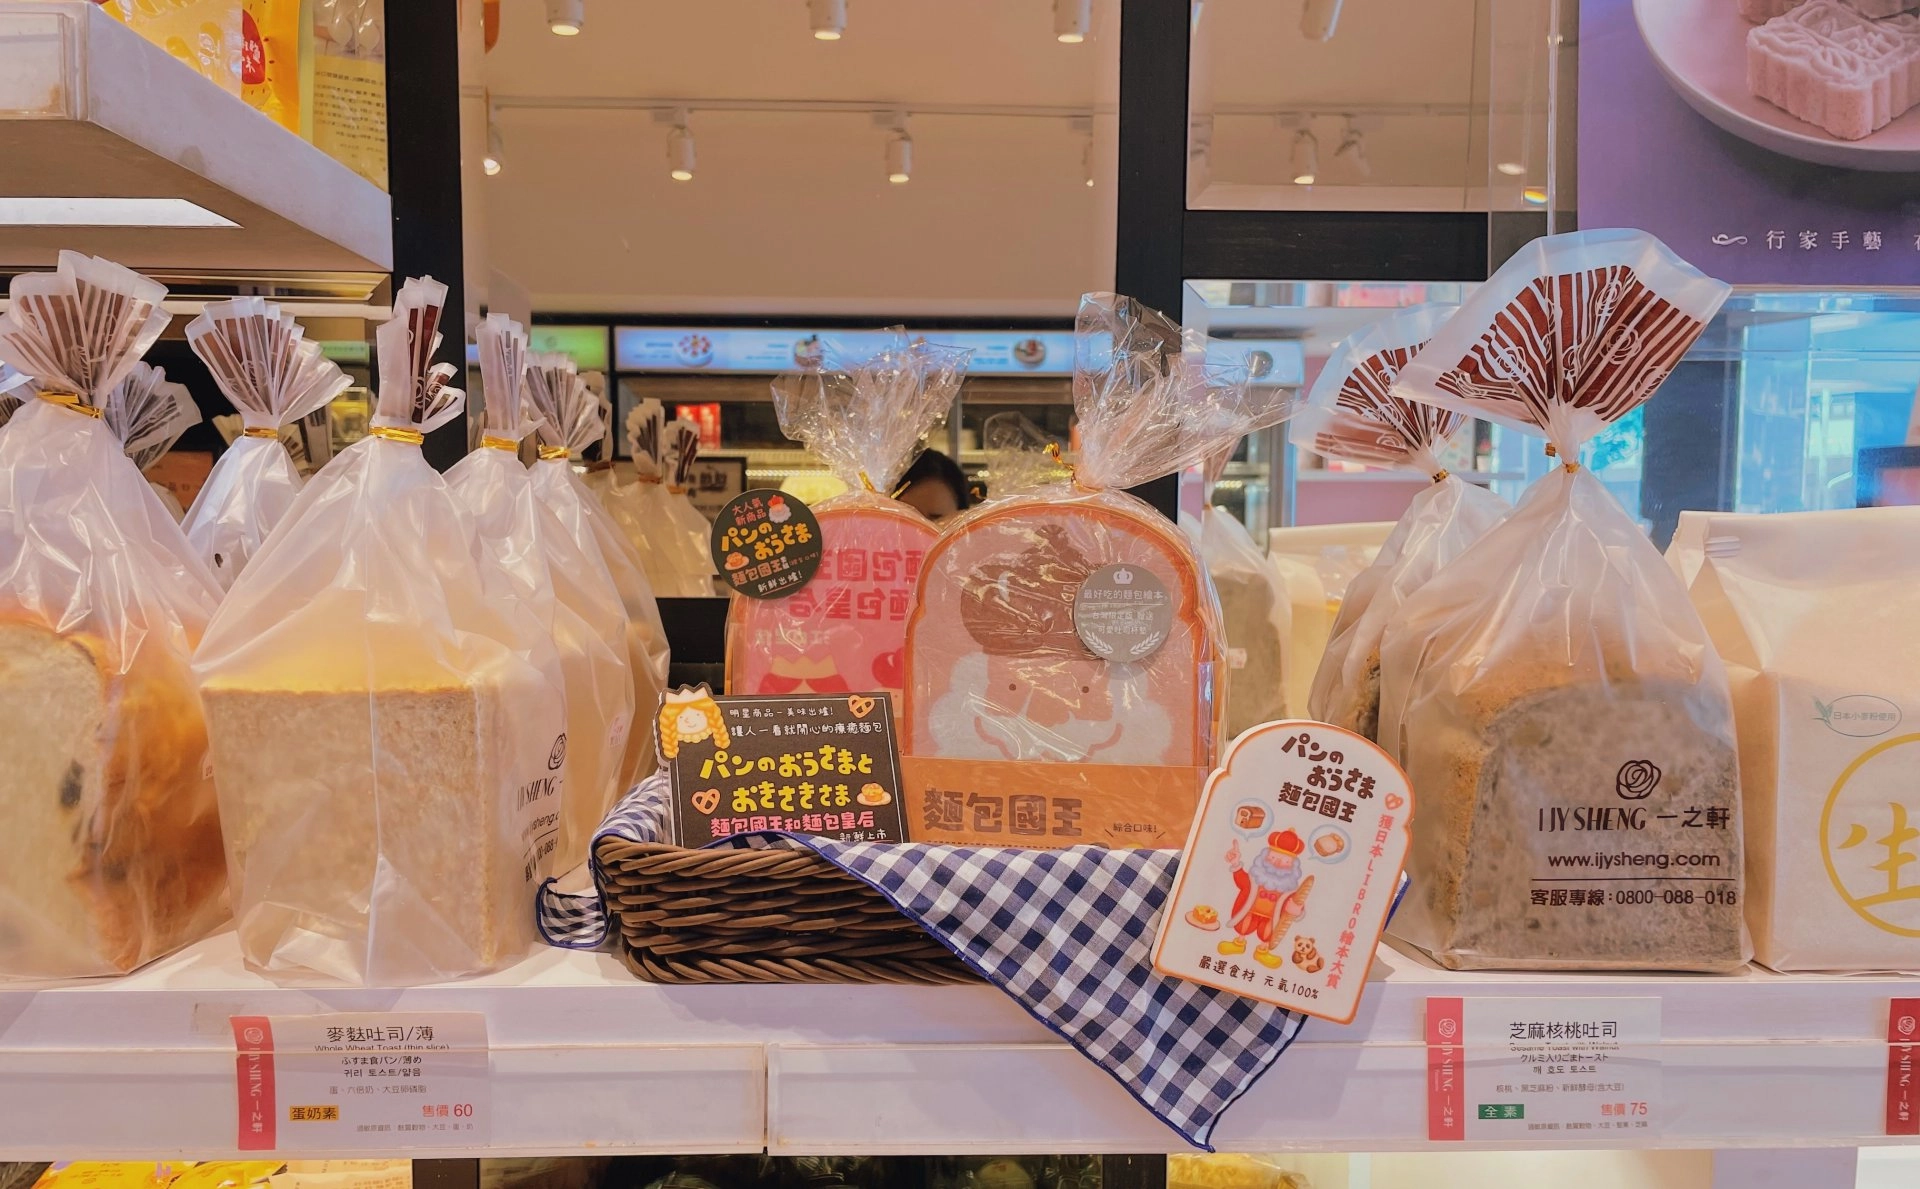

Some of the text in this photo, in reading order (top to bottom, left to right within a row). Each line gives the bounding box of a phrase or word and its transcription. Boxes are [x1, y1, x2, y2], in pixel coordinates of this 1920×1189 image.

[1766, 230, 1882, 250] 行家手藝
[732, 497, 763, 515] 大人氣
[735, 509, 767, 526] 新商品
[722, 522, 772, 552] パンの
[754, 523, 812, 560] おうさま
[1281, 733, 1345, 765] パンの
[699, 744, 873, 780] パンのおうさまと
[1306, 765, 1377, 800] おうさま
[731, 780, 852, 813] おきさきさま
[1278, 781, 1358, 823] 麵包國王
[710, 810, 875, 837] 麵包國王和麵包皇后
[923, 787, 1082, 838] 麵包國王
[1657, 806, 1730, 830] 一之軒
[1547, 851, 1721, 870] www.ijysheng.com
[1198, 955, 1320, 1000] 嚴選食材 元氣100%
[326, 1026, 434, 1042] 麥麩吐司/薄
[1509, 1021, 1617, 1039] 芝麻核桃吐司
[1570, 1065, 1597, 1074] 토스트
[291, 1107, 337, 1120] 蛋奶素
[421, 1103, 473, 1117] 售價 60
[1601, 1102, 1648, 1116] 售價 75
